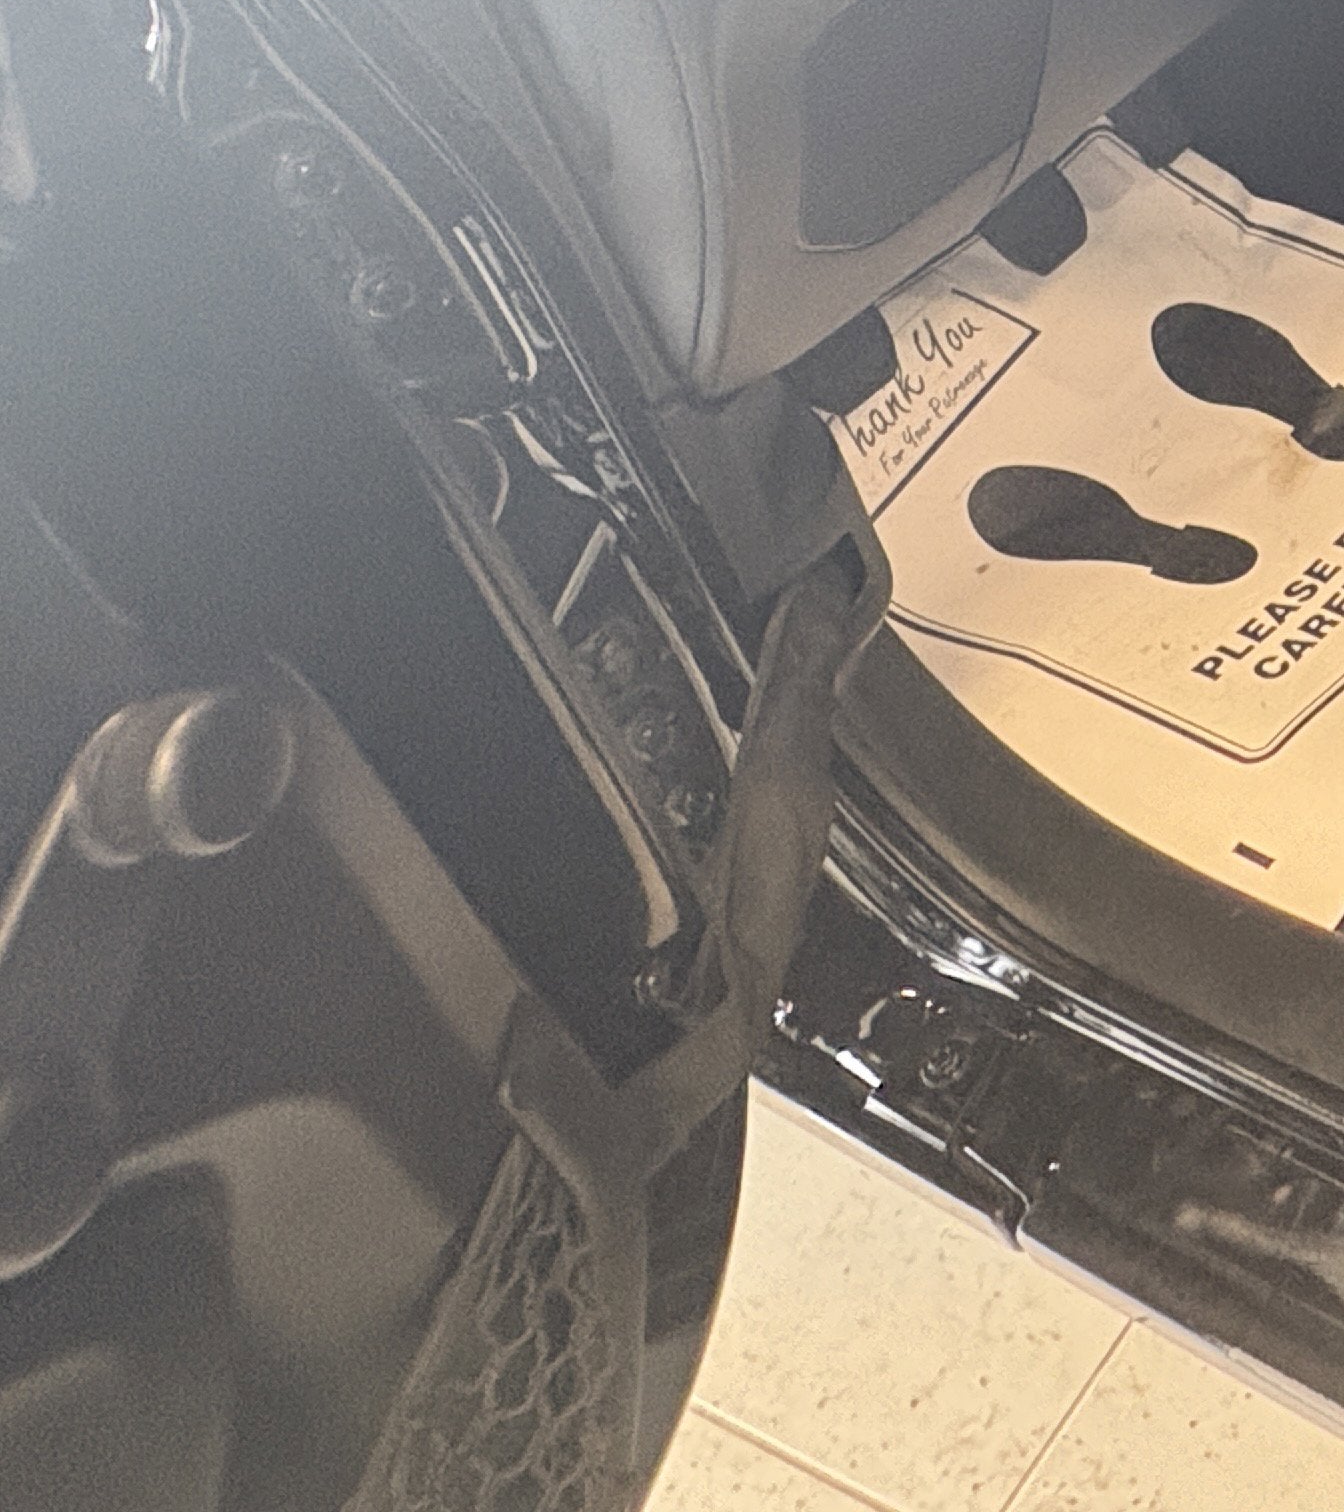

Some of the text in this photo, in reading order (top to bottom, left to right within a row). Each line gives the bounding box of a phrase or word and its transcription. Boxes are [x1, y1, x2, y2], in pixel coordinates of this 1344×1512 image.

[841, 317, 984, 458] hank You
[879, 449, 904, 477] For
[1191, 558, 1342, 681] PLEASE
